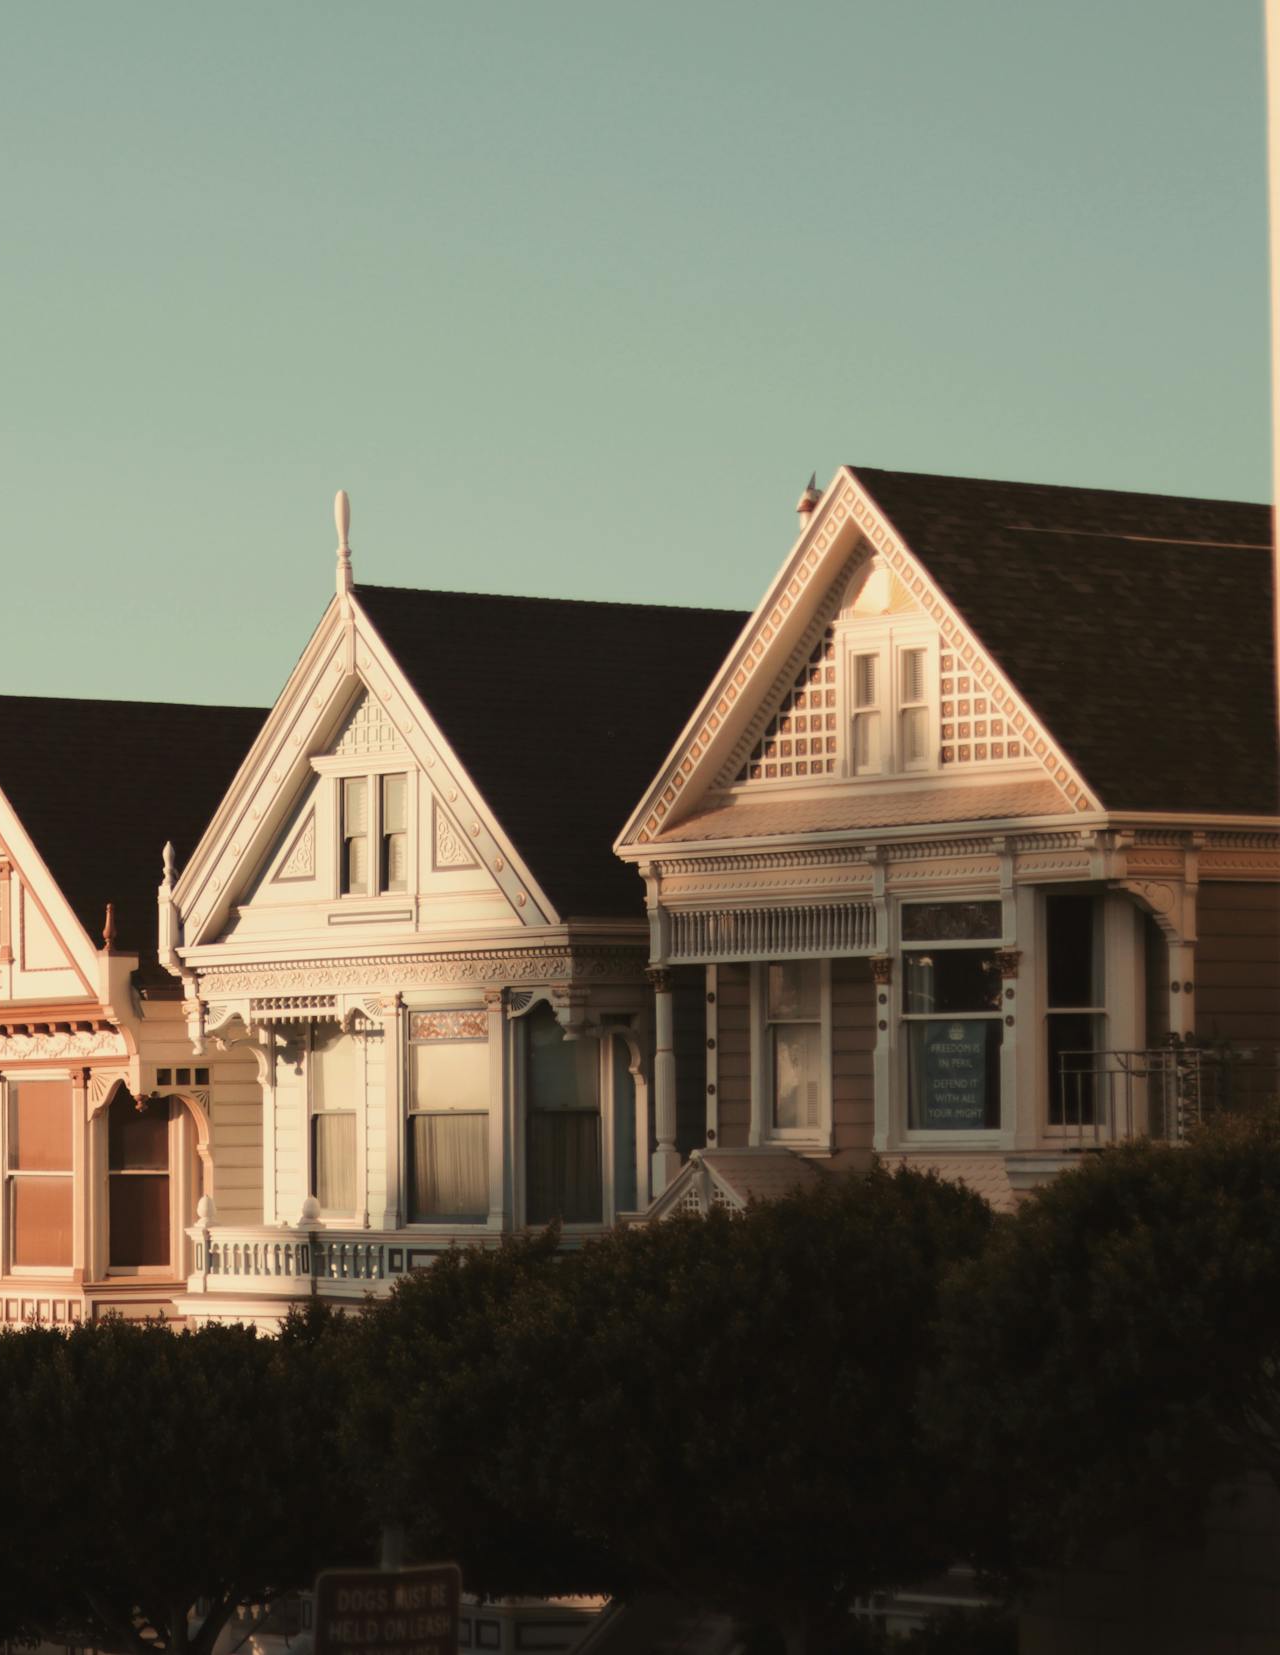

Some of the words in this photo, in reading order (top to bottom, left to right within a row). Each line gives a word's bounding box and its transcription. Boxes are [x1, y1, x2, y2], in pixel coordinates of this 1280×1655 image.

[931, 1043, 972, 1053] FREEDOM
[973, 1043, 980, 1053] IS
[939, 1058, 949, 1068] IN
[951, 1057, 973, 1068] PERIL
[933, 1079, 968, 1089] DEFEND
[970, 1079, 977, 1088] IT
[935, 1094, 959, 1104] WITH
[961, 1094, 976, 1104] ALL
[929, 1108, 953, 1118] YOUR
[955, 1108, 983, 1119] MIGHT
[337, 1588, 388, 1612] DOGS
[395, 1584, 428, 1609] MUST
[431, 1583, 448, 1608] BE
[328, 1619, 379, 1643] HELD
[384, 1617, 405, 1642] ON
[406, 1614, 451, 1640] LEASH
